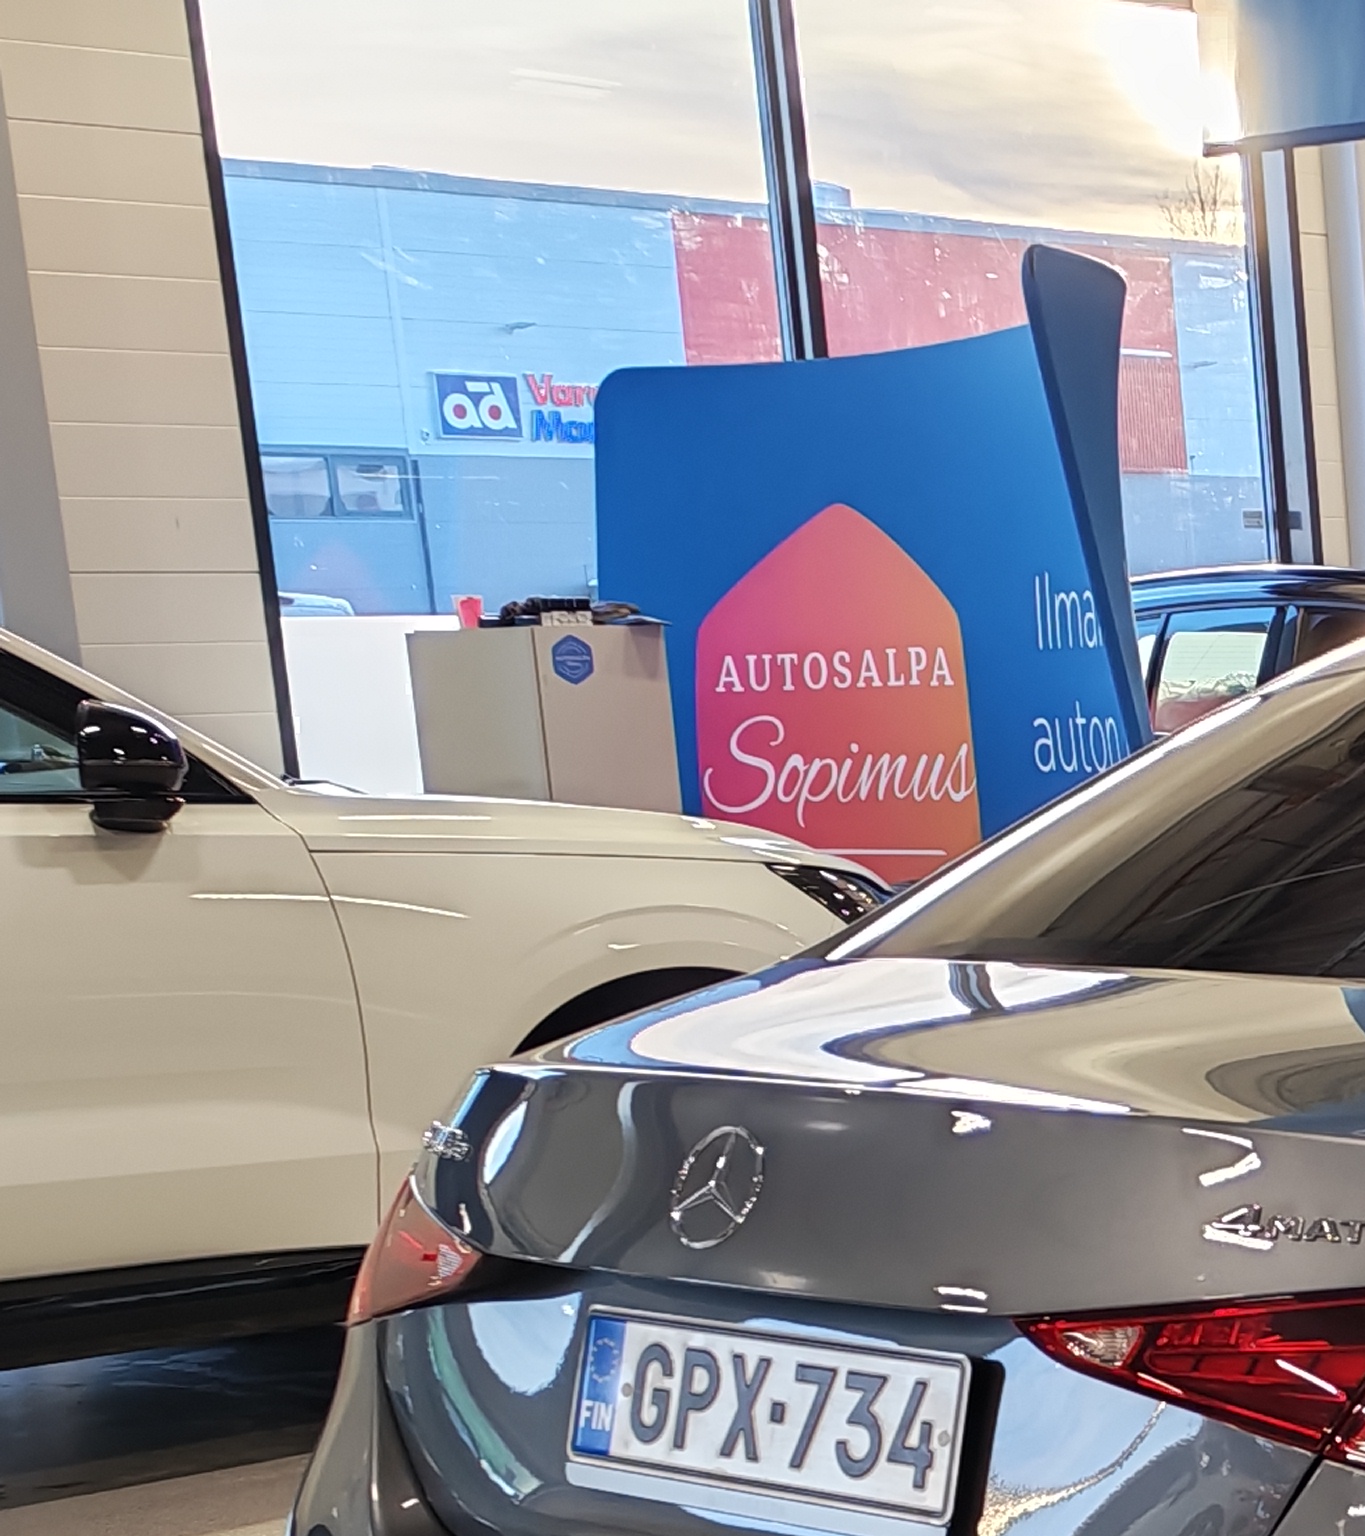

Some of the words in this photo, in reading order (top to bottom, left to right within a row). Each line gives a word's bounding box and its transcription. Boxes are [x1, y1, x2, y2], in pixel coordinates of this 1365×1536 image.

[715, 645, 955, 693] AUTOSALPA
[703, 715, 977, 828] Sopimus
[1033, 700, 1122, 773] auton
[578, 1399, 614, 1432] FIN
[629, 1341, 934, 1490] GPX-734
